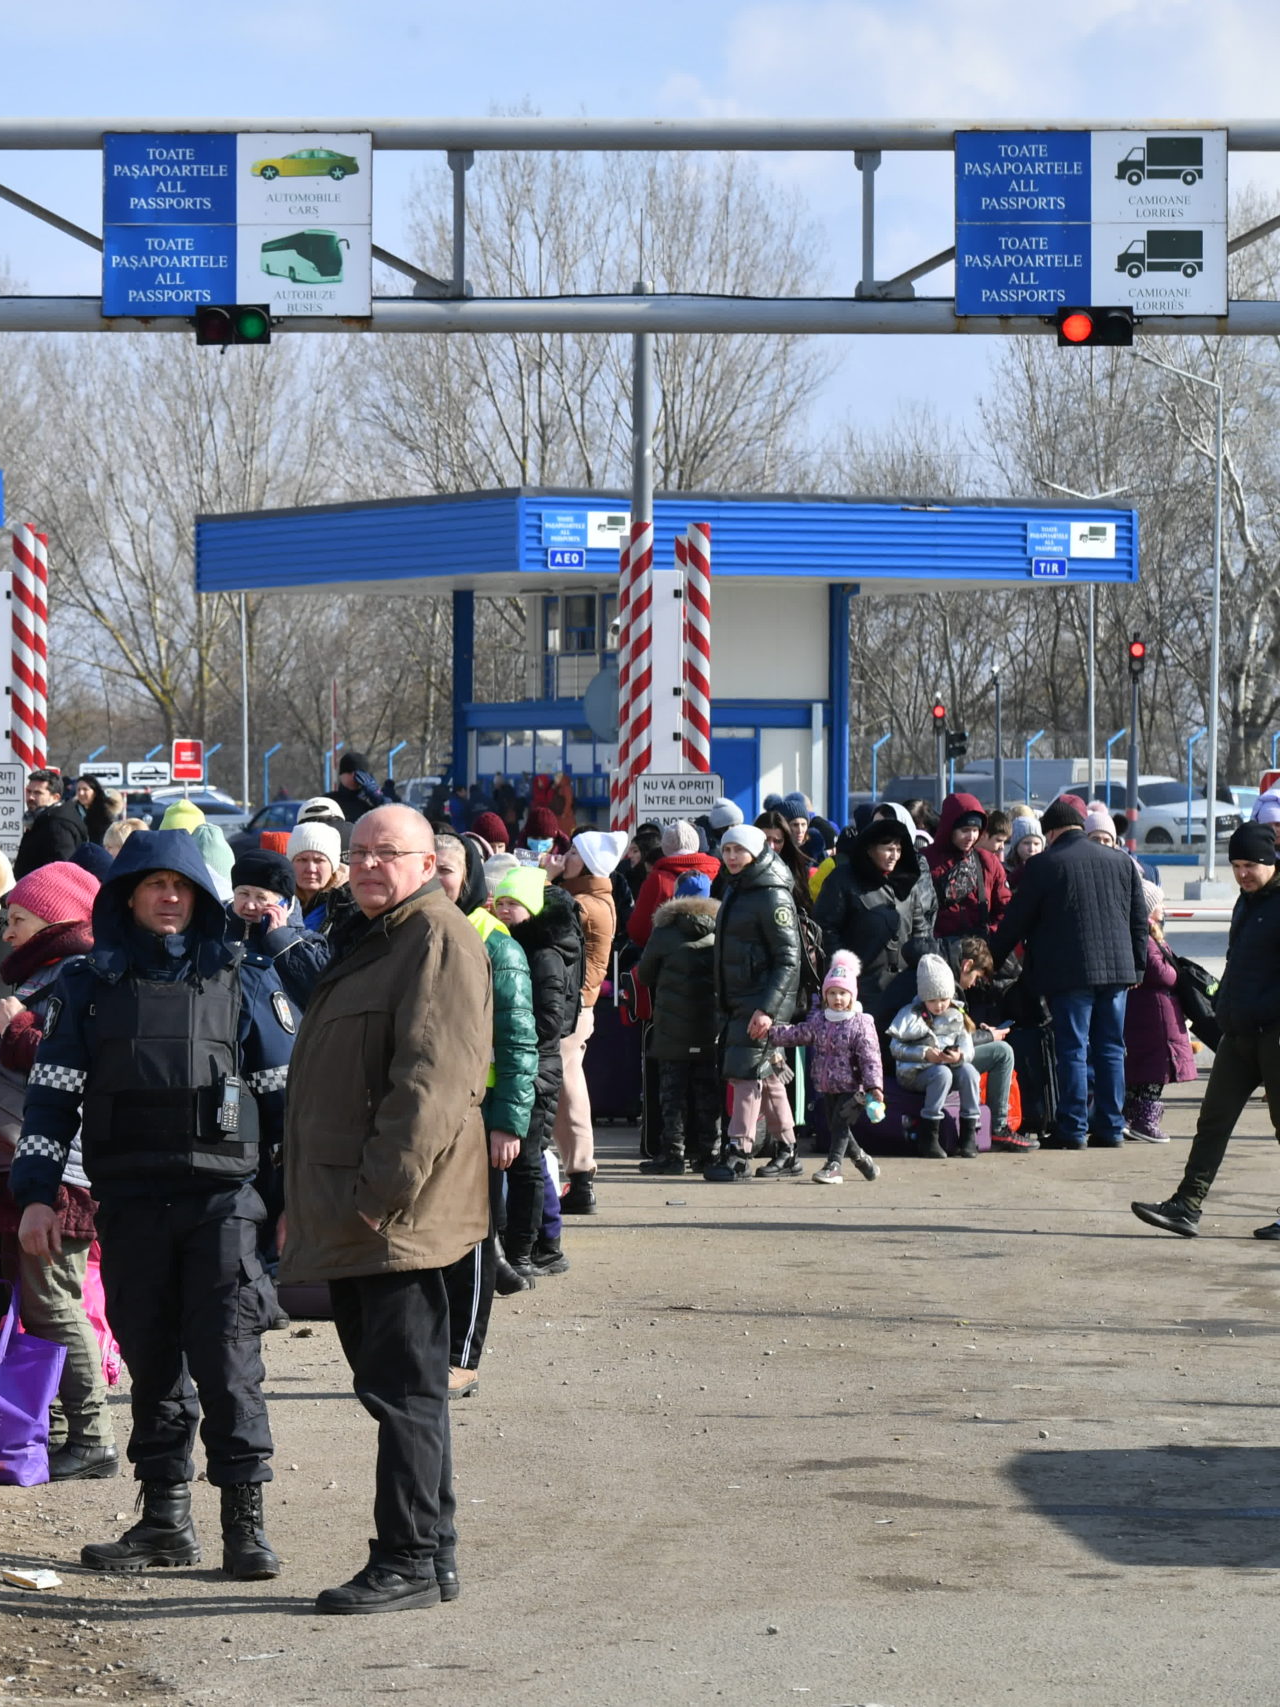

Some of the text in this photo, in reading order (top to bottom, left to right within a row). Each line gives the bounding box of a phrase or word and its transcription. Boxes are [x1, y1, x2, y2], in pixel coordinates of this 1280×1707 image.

[146, 148, 195, 160] TOATE
[998, 144, 1048, 158] TOATE
[156, 181, 186, 193] ALL
[1008, 179, 1039, 192] ALL
[129, 197, 212, 210] PASSPORTS
[266, 193, 341, 203] AUTOMOBILE
[981, 196, 1066, 210] PASSPORTS
[1128, 195, 1191, 205] CAMIOANE
[288, 206, 319, 215] CARS
[1135, 208, 1184, 218] LORRIES
[145, 238, 194, 251] TOATE
[998, 237, 1048, 250] TOATE
[154, 272, 185, 285] ALL
[1008, 272, 1039, 285] ALL
[128, 289, 211, 302] PASSPORTS
[274, 290, 336, 300] AUTOBUZE
[981, 289, 1066, 303] PASSPORTS
[1128, 288, 1191, 298] CAMIOANE
[287, 303, 323, 312] BUSES
[1135, 301, 1184, 311] LORRIES
[1039, 562, 1059, 574] TIR
[643, 780, 658, 791] NU
[644, 794, 714, 805] ÎNTRE PILONI
